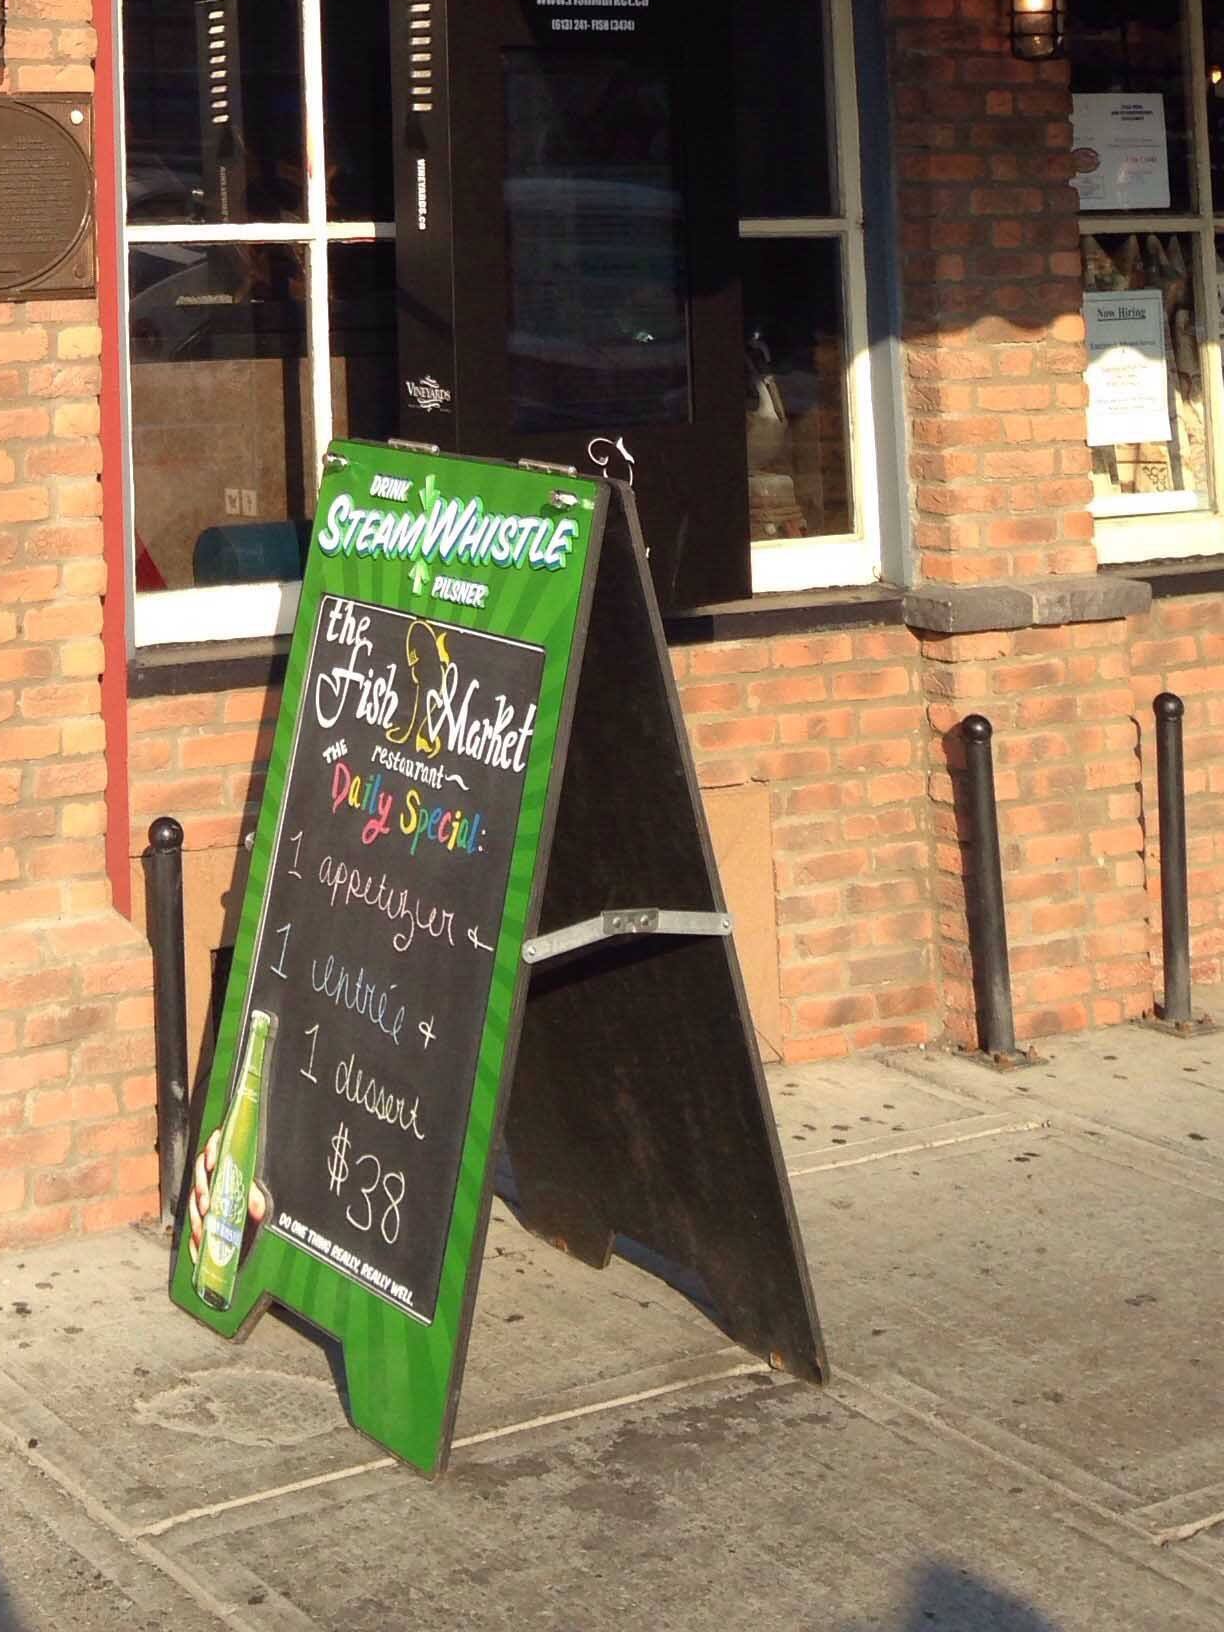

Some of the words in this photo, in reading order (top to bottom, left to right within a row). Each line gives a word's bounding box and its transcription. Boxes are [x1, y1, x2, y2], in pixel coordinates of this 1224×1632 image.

[1097, 307, 1115, 320] Now
[1118, 303, 1147, 319] Hiring
[405, 380, 451, 402] VINEYARDS
[369, 473, 413, 503] DRINK
[430, 575, 489, 608] PILSNER
[326, 598, 372, 646] the
[426, 662, 537, 773] Market
[322, 738, 348, 764] THE
[371, 745, 444, 790] restaurant
[330, 761, 394, 846] Daily
[399, 789, 488, 855] Special:
[287, 831, 304, 879] 1
[270, 923, 292, 980] 1
[300, 1023, 320, 1084] 1
[335, 1052, 426, 1141] dessert
[327, 1121, 406, 1245] $38
[278, 1211, 292, 1230] DO
[291, 1220, 309, 1240] ONE
[307, 1229, 332, 1254] THING
[360, 1263, 392, 1290] REALLY
[390, 1280, 414, 1307] WELL.
